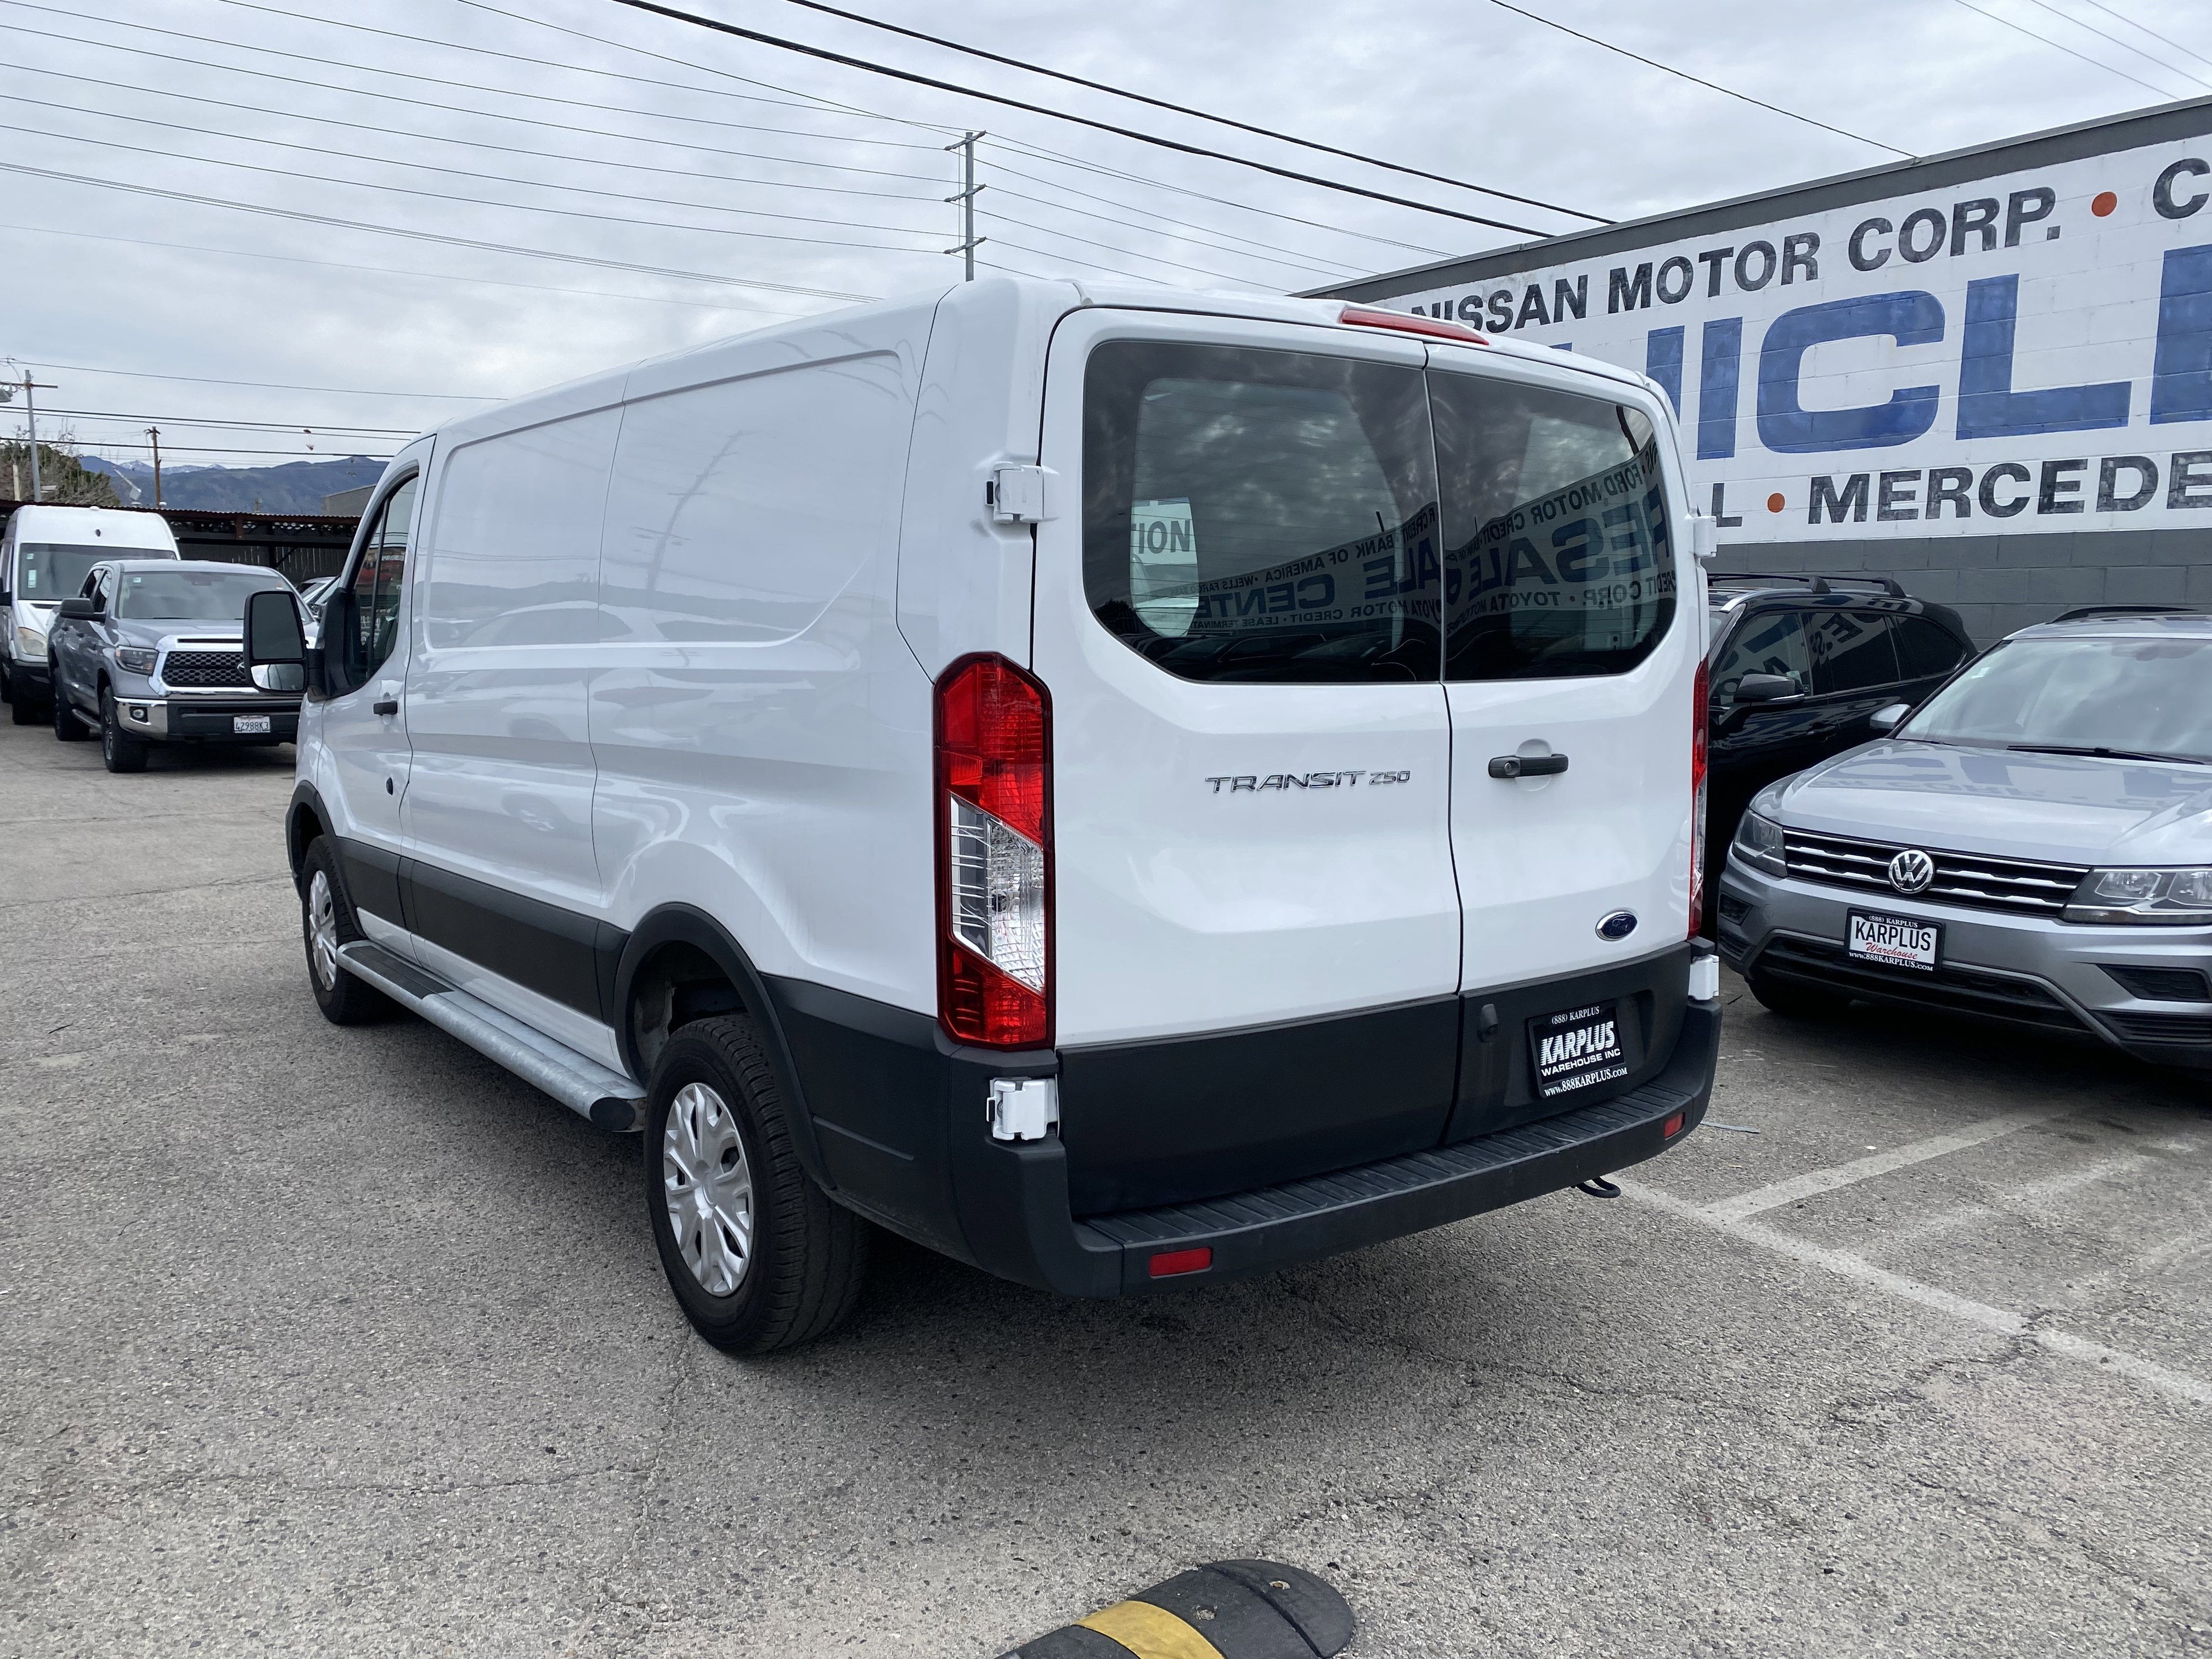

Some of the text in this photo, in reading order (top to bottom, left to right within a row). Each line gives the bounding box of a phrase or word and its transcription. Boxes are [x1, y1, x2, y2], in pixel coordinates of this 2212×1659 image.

[1608, 232, 1820, 314] MOTOR
[1848, 186, 2061, 271] CORP.
[1205, 770, 1411, 794] TRANSIT 250
[1855, 921, 1932, 951] KARPLUS
[1886, 918, 1918, 928] KARPLUS
[1865, 942, 1918, 960] Warehouse
[1551, 1006, 1600, 1025] (888) KARPLUS
[1540, 1021, 1615, 1066] KARPLUS
[1541, 1048, 1621, 1076] WAREHOUSE INC
